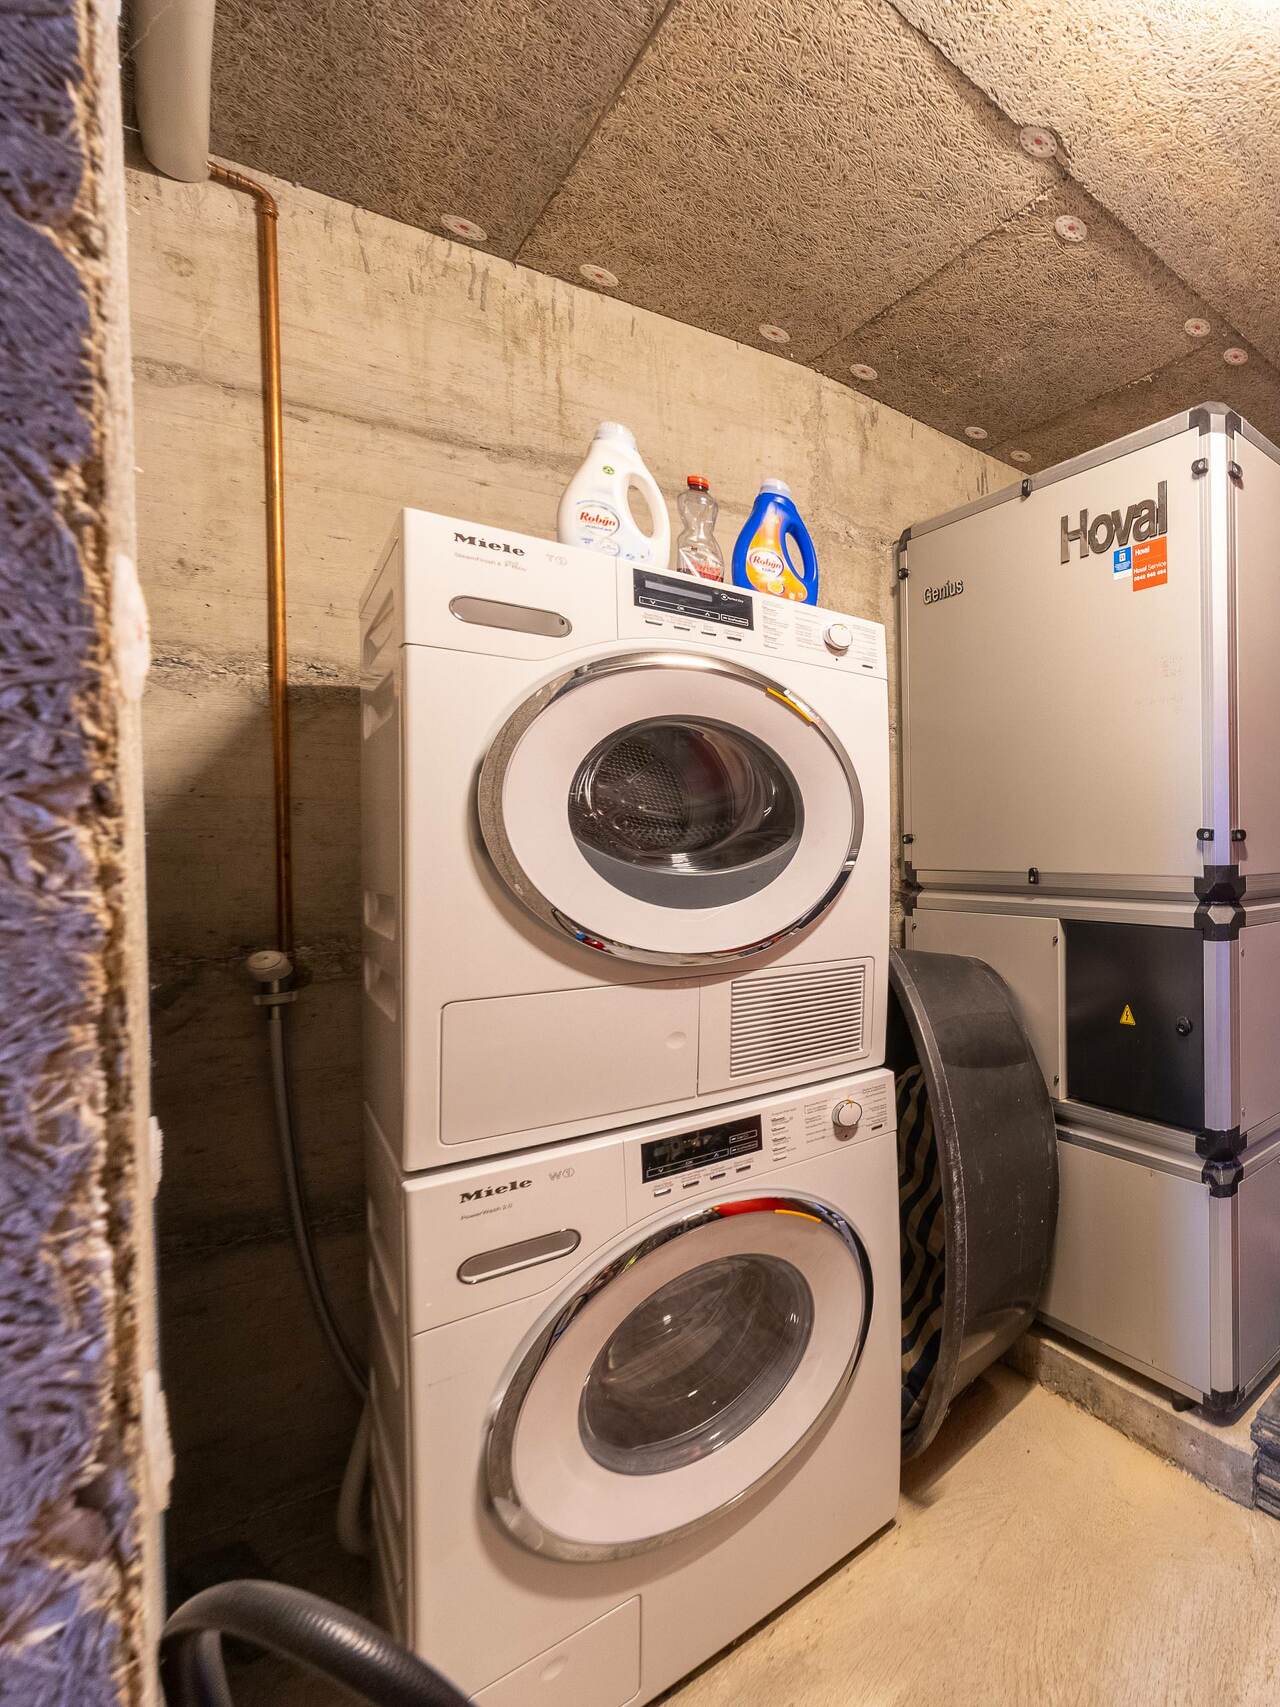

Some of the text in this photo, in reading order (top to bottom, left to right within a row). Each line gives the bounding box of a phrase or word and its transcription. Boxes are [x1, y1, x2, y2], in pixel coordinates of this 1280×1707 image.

[1060, 480, 1168, 566] Hoval
[454, 532, 526, 557] Miele
[1135, 546, 1150, 556] Hoval
[1147, 562, 1167, 571] Service
[923, 578, 964, 605] Genius
[459, 1179, 533, 1204] Miele
